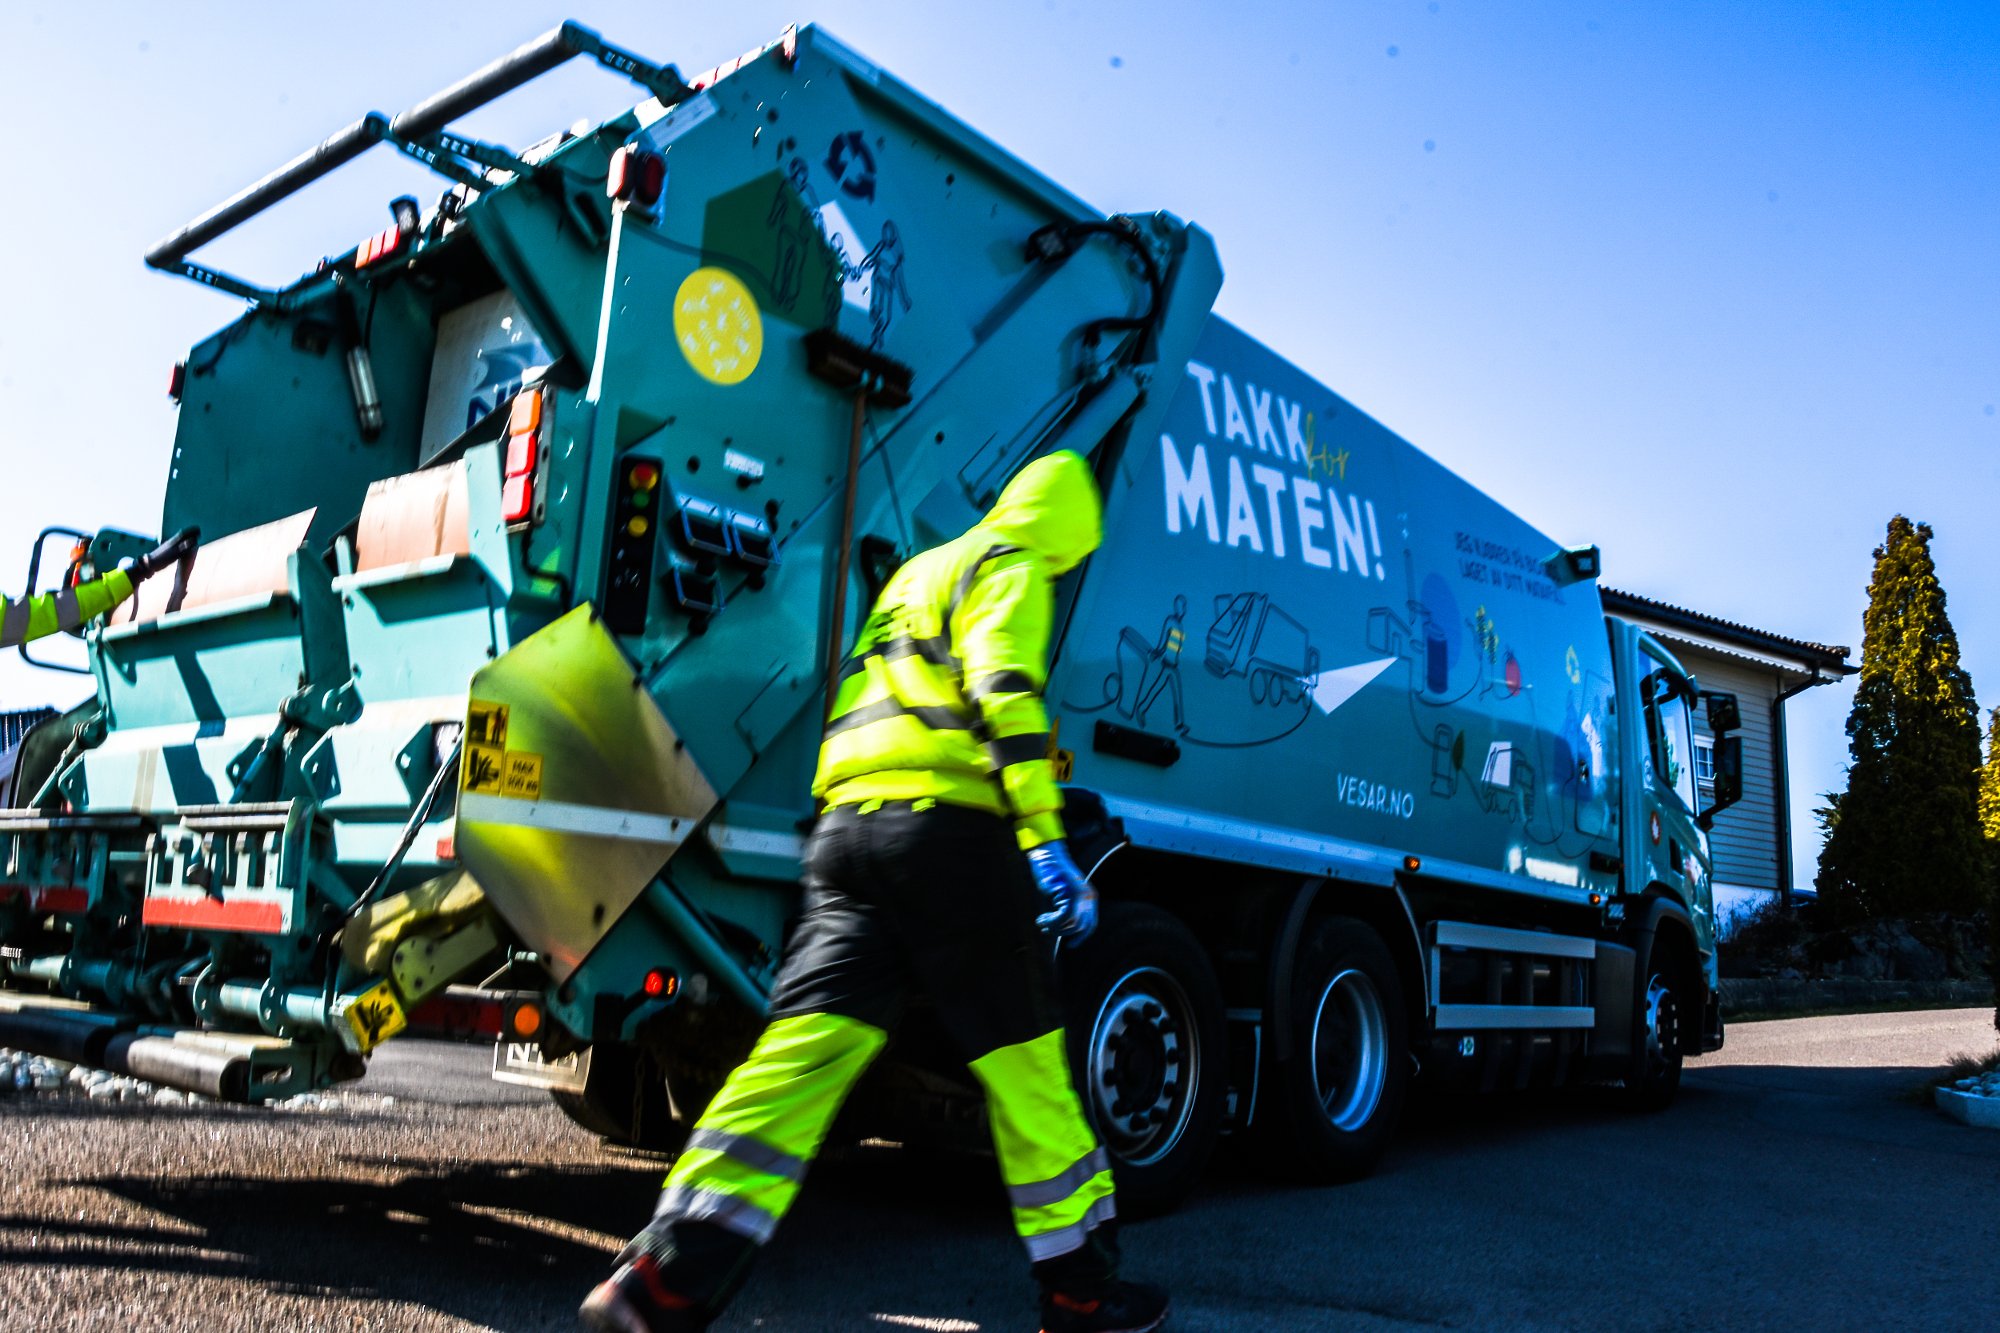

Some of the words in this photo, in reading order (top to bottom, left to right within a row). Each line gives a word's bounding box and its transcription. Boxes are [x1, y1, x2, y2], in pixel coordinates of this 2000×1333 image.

[1185, 359, 1315, 470] TAKK
[1161, 433, 1385, 581] MATEN!
[1337, 772, 1414, 819] VESAR.NO
